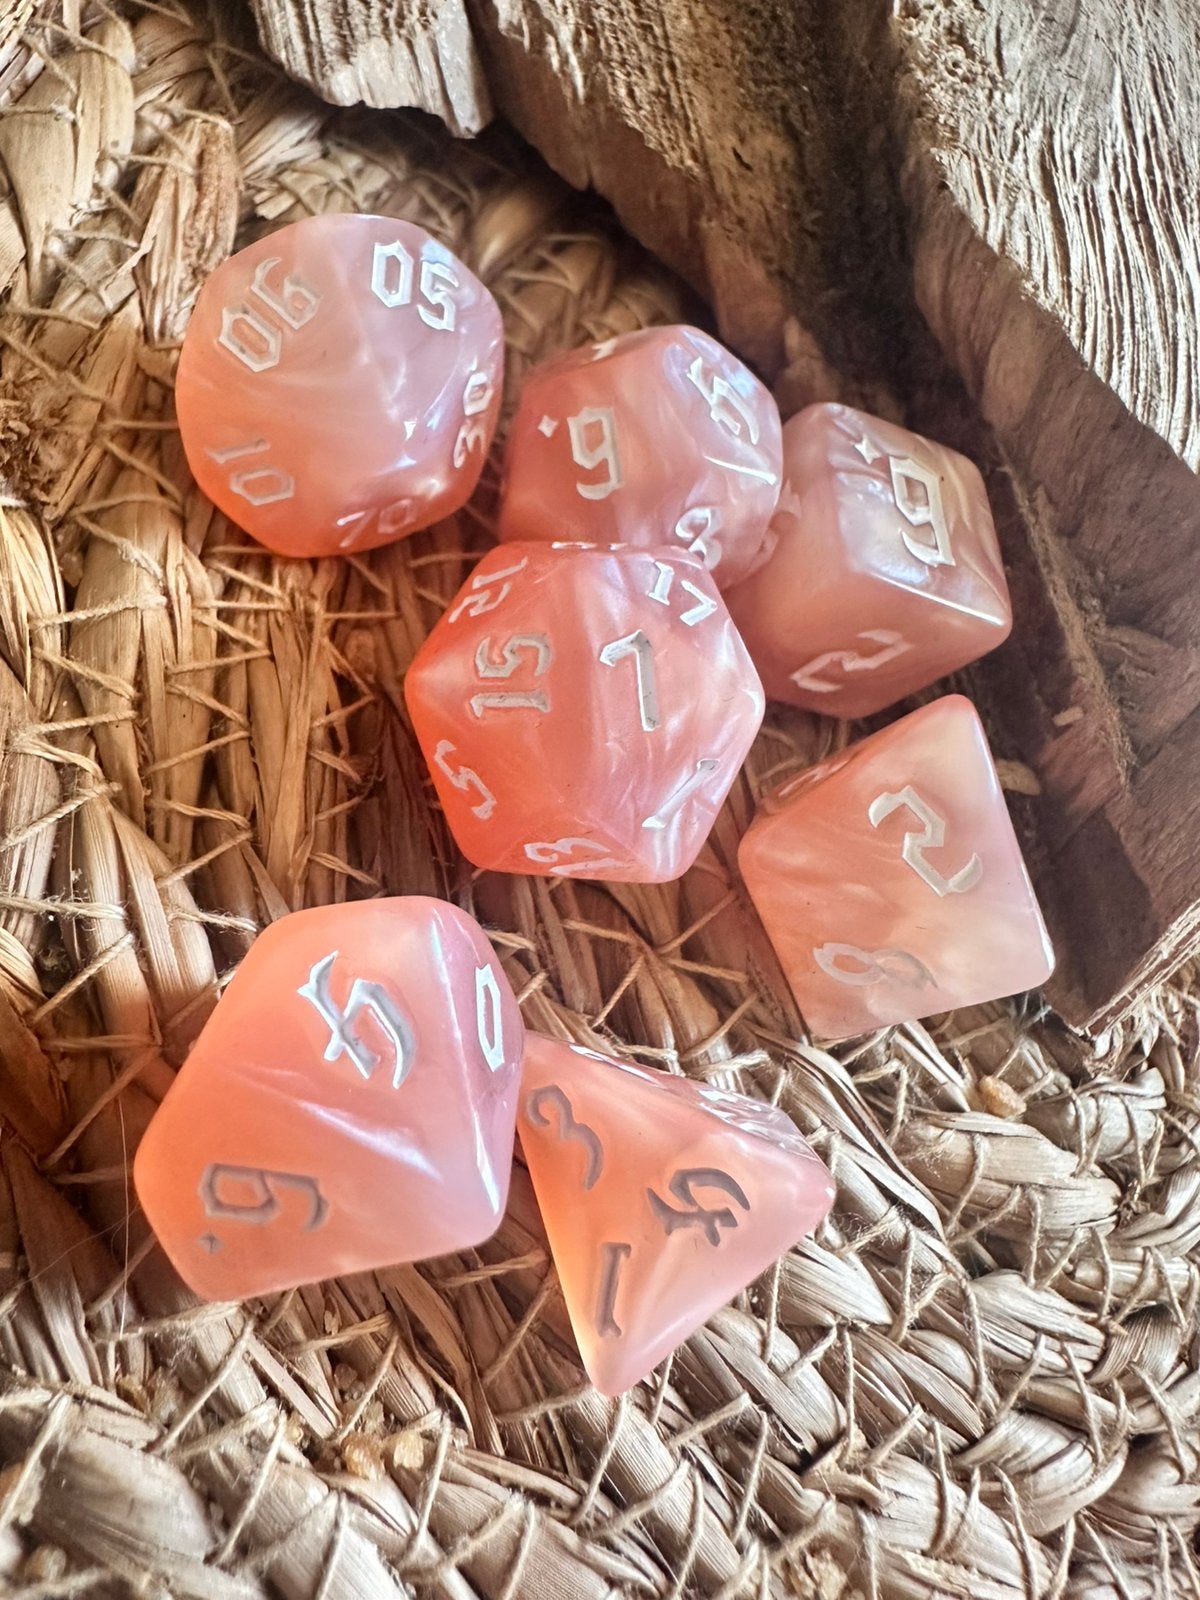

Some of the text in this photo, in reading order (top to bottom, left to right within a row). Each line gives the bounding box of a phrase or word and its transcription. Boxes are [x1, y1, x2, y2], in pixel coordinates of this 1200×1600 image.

[648, 560, 718, 627] 17
[469, 632, 551, 719] 15
[600, 629, 660, 732] 7
[868, 785, 984, 898] 2
[813, 942, 939, 990] 8
[297, 950, 417, 1090] 4
[526, 1084, 605, 1192] 3
[595, 1241, 632, 1338] 1
